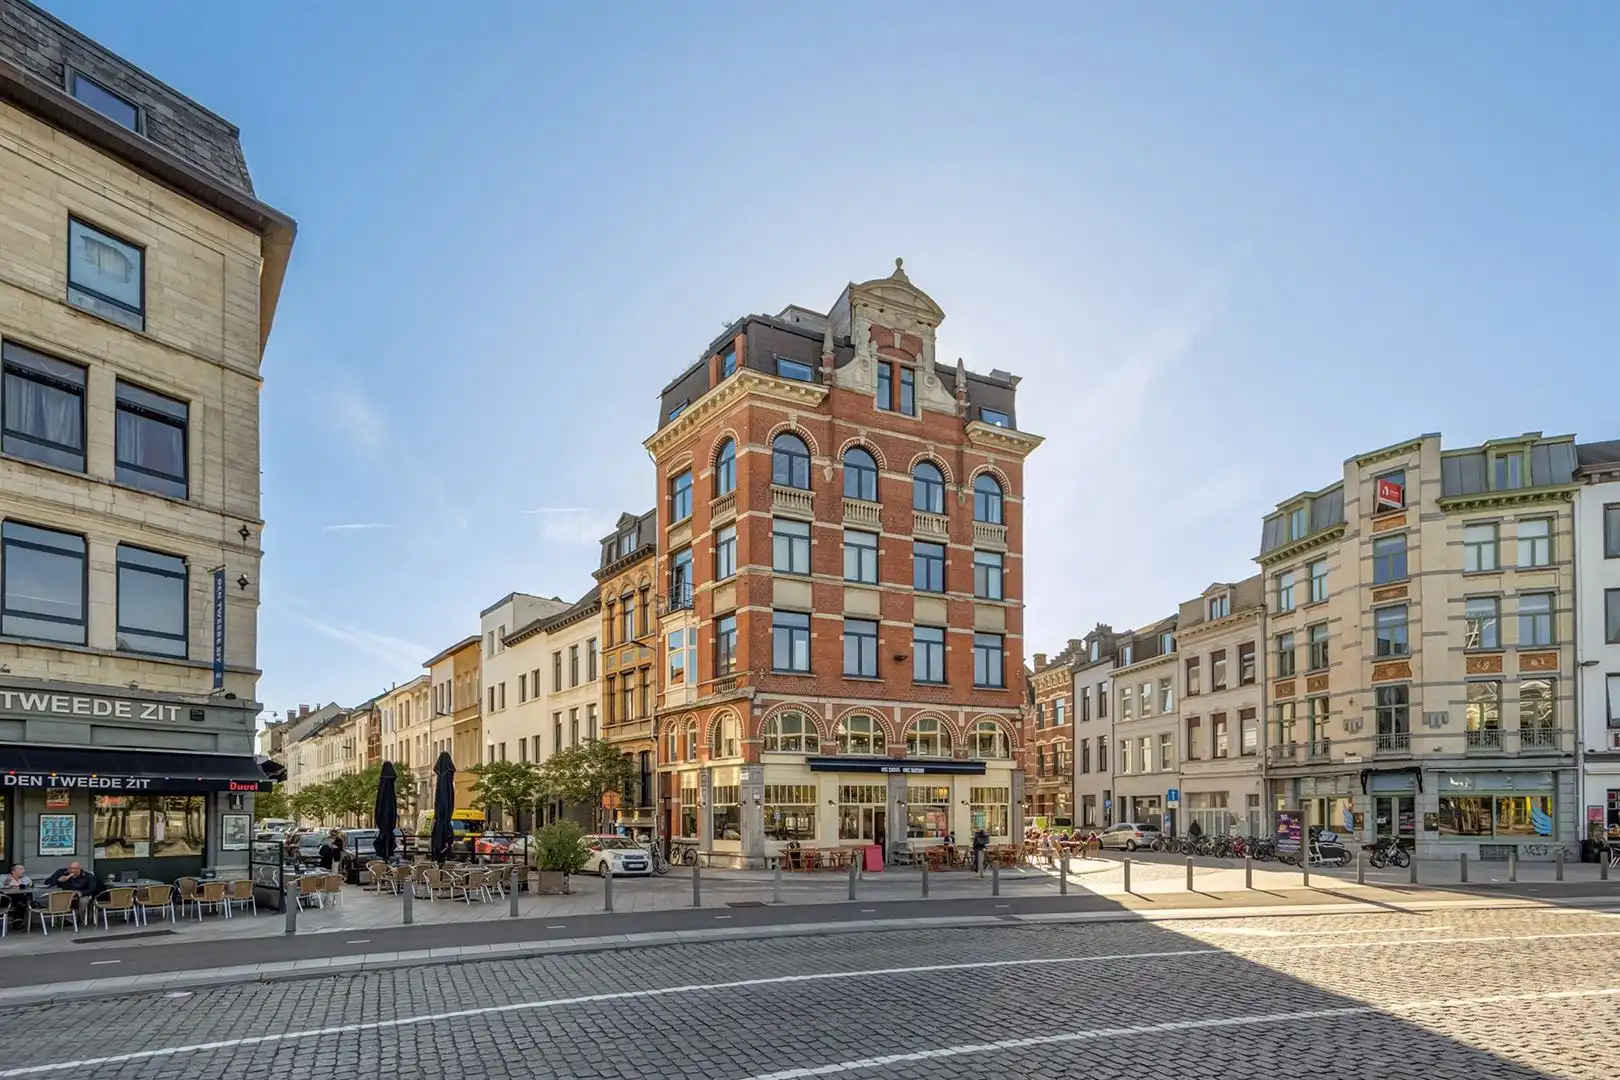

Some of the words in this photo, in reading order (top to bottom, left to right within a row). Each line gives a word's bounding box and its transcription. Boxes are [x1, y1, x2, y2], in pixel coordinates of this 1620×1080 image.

[0, 691, 132, 718] TWEEDE
[140, 703, 182, 721] ZIT
[4, 775, 42, 786] DEN
[48, 776, 122, 788] TWEEDE
[126, 778, 151, 789] ZIT
[229, 782, 258, 791] Duvel
